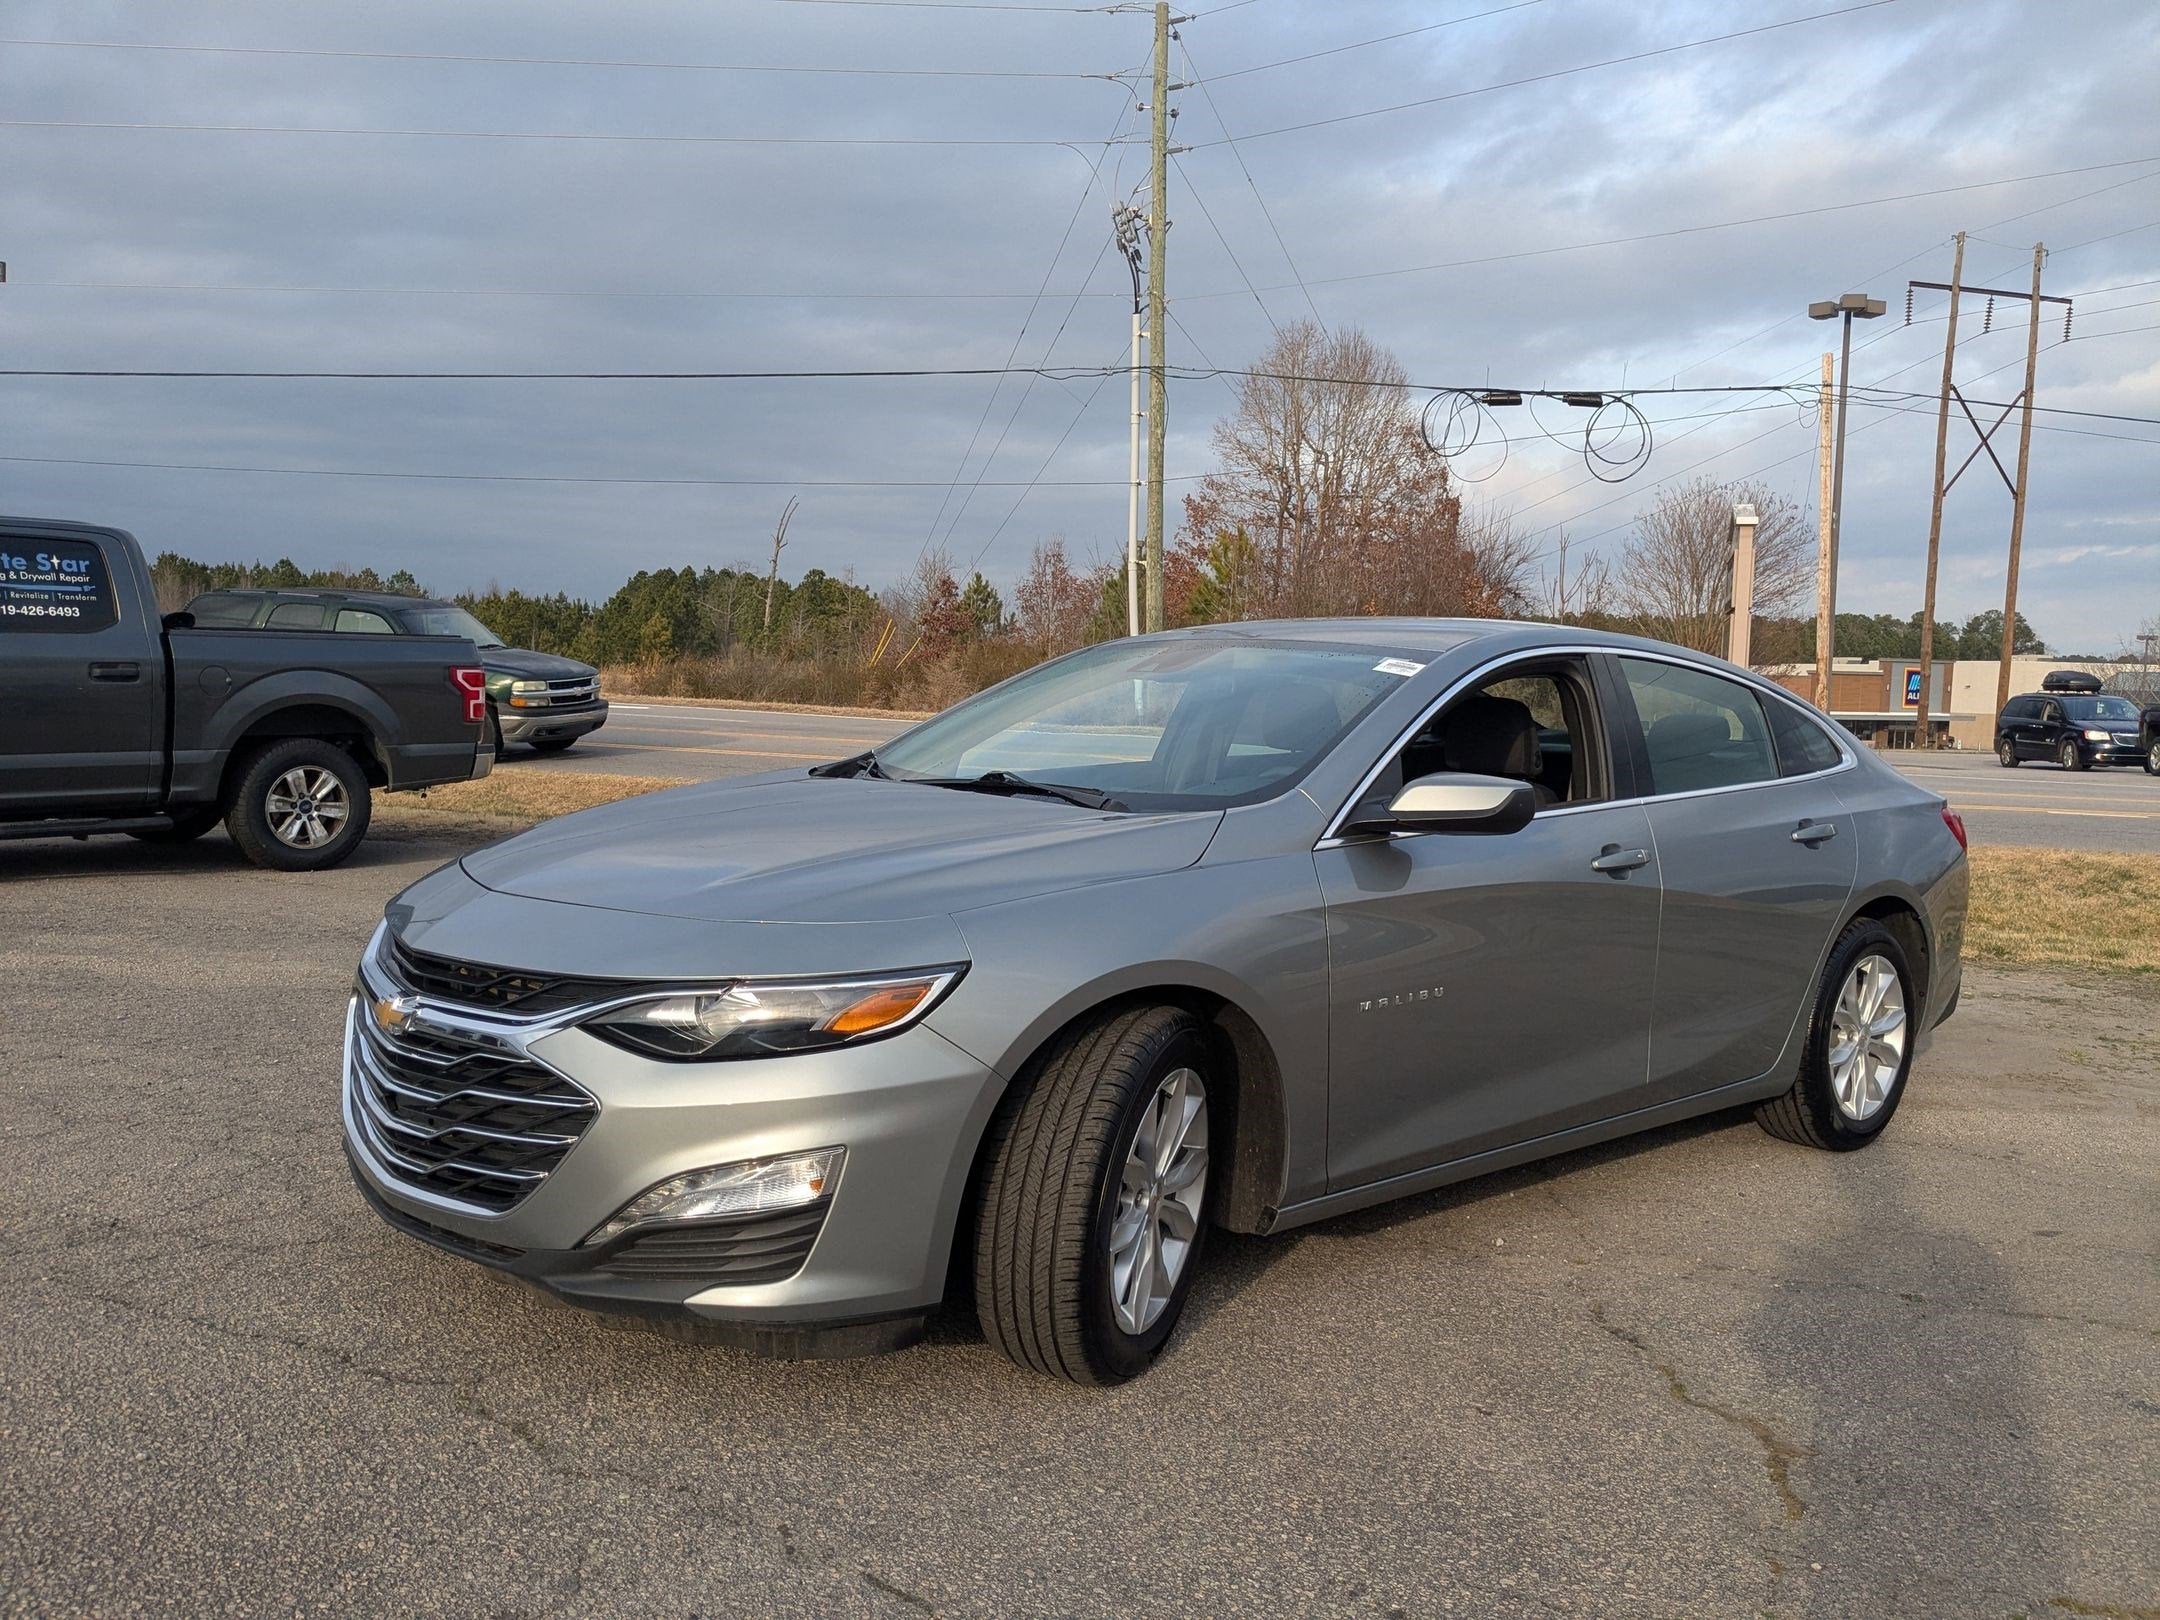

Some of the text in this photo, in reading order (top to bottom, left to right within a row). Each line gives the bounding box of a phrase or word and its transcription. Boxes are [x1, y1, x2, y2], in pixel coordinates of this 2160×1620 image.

[9, 571, 17, 579] &
[20, 571, 57, 582] Drywall
[60, 573, 91, 584] Repair
[10, 591, 49, 600] Revitalize
[57, 593, 97, 601] Transform
[1359, 986, 1444, 1012] MALIBU
